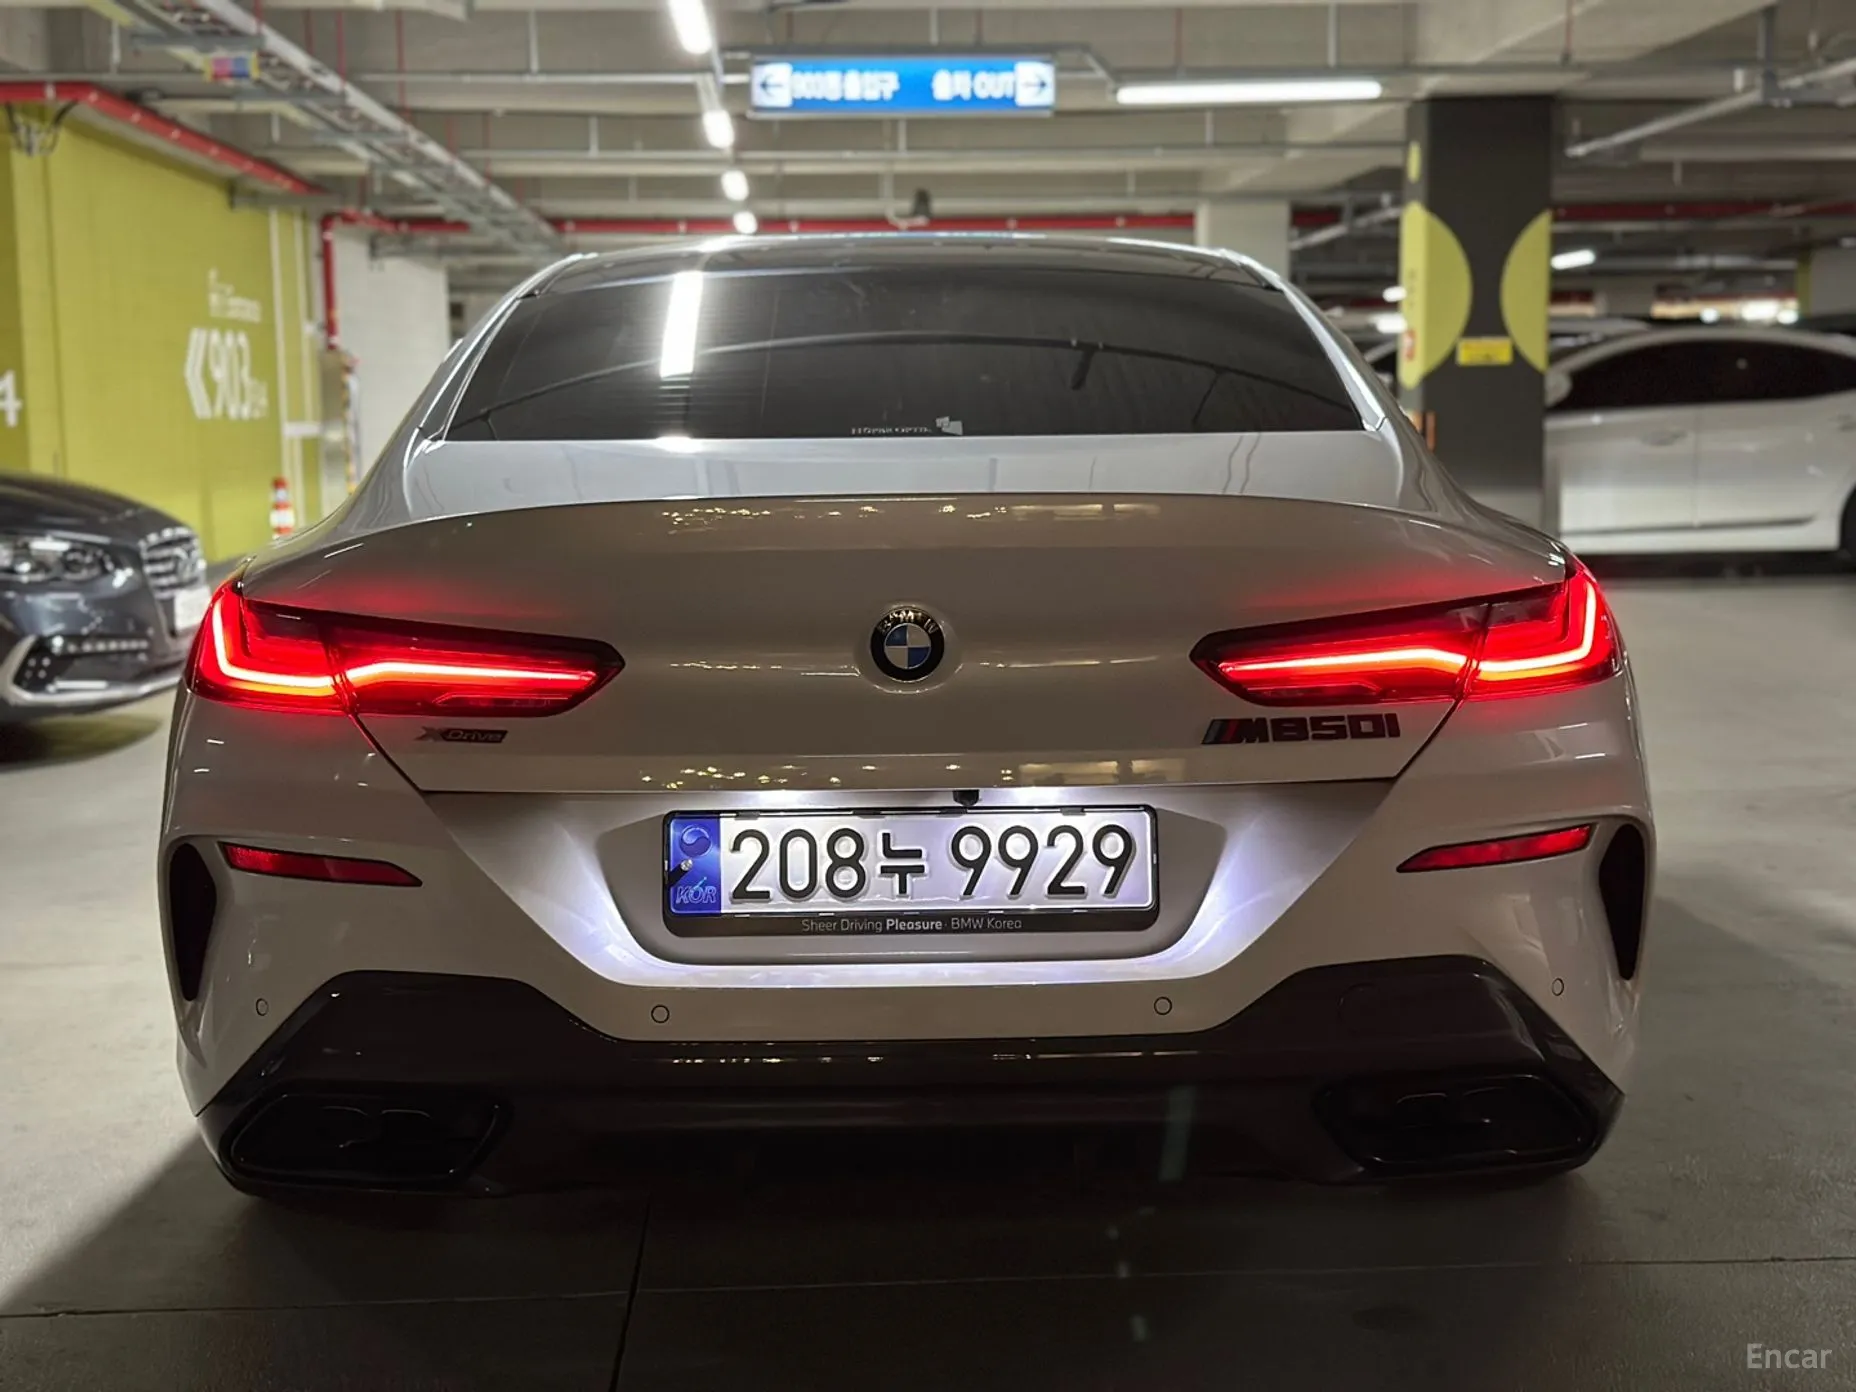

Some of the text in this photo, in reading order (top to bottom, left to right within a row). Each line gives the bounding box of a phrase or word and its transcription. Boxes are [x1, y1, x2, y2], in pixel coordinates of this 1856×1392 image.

[730, 824, 1135, 901] 208누 9929
[675, 885, 718, 904] KOR
[801, 916, 1023, 933] Sheer Driving Pleasure BMW Korea
